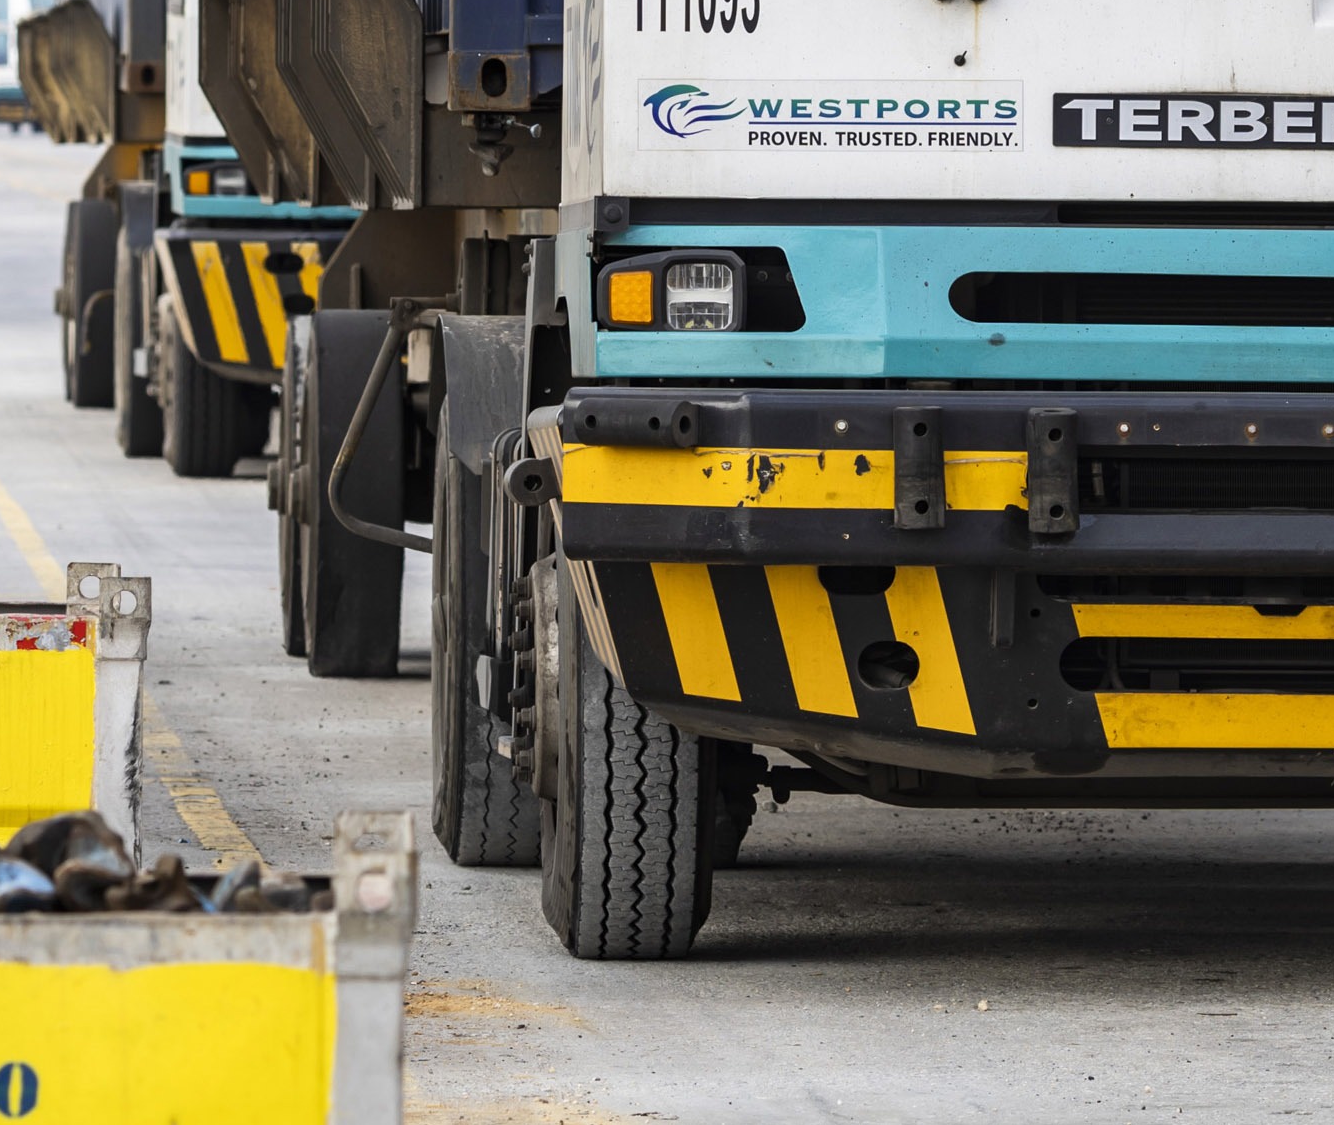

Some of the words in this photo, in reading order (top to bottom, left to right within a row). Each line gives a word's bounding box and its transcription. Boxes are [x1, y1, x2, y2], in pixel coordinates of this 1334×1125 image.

[749, 98, 1018, 119] WESTPORTS
[748, 131, 827, 146] PROVEN.
[835, 131, 922, 147] TRUSTED.
[928, 131, 1018, 147] FRIENDLY.
